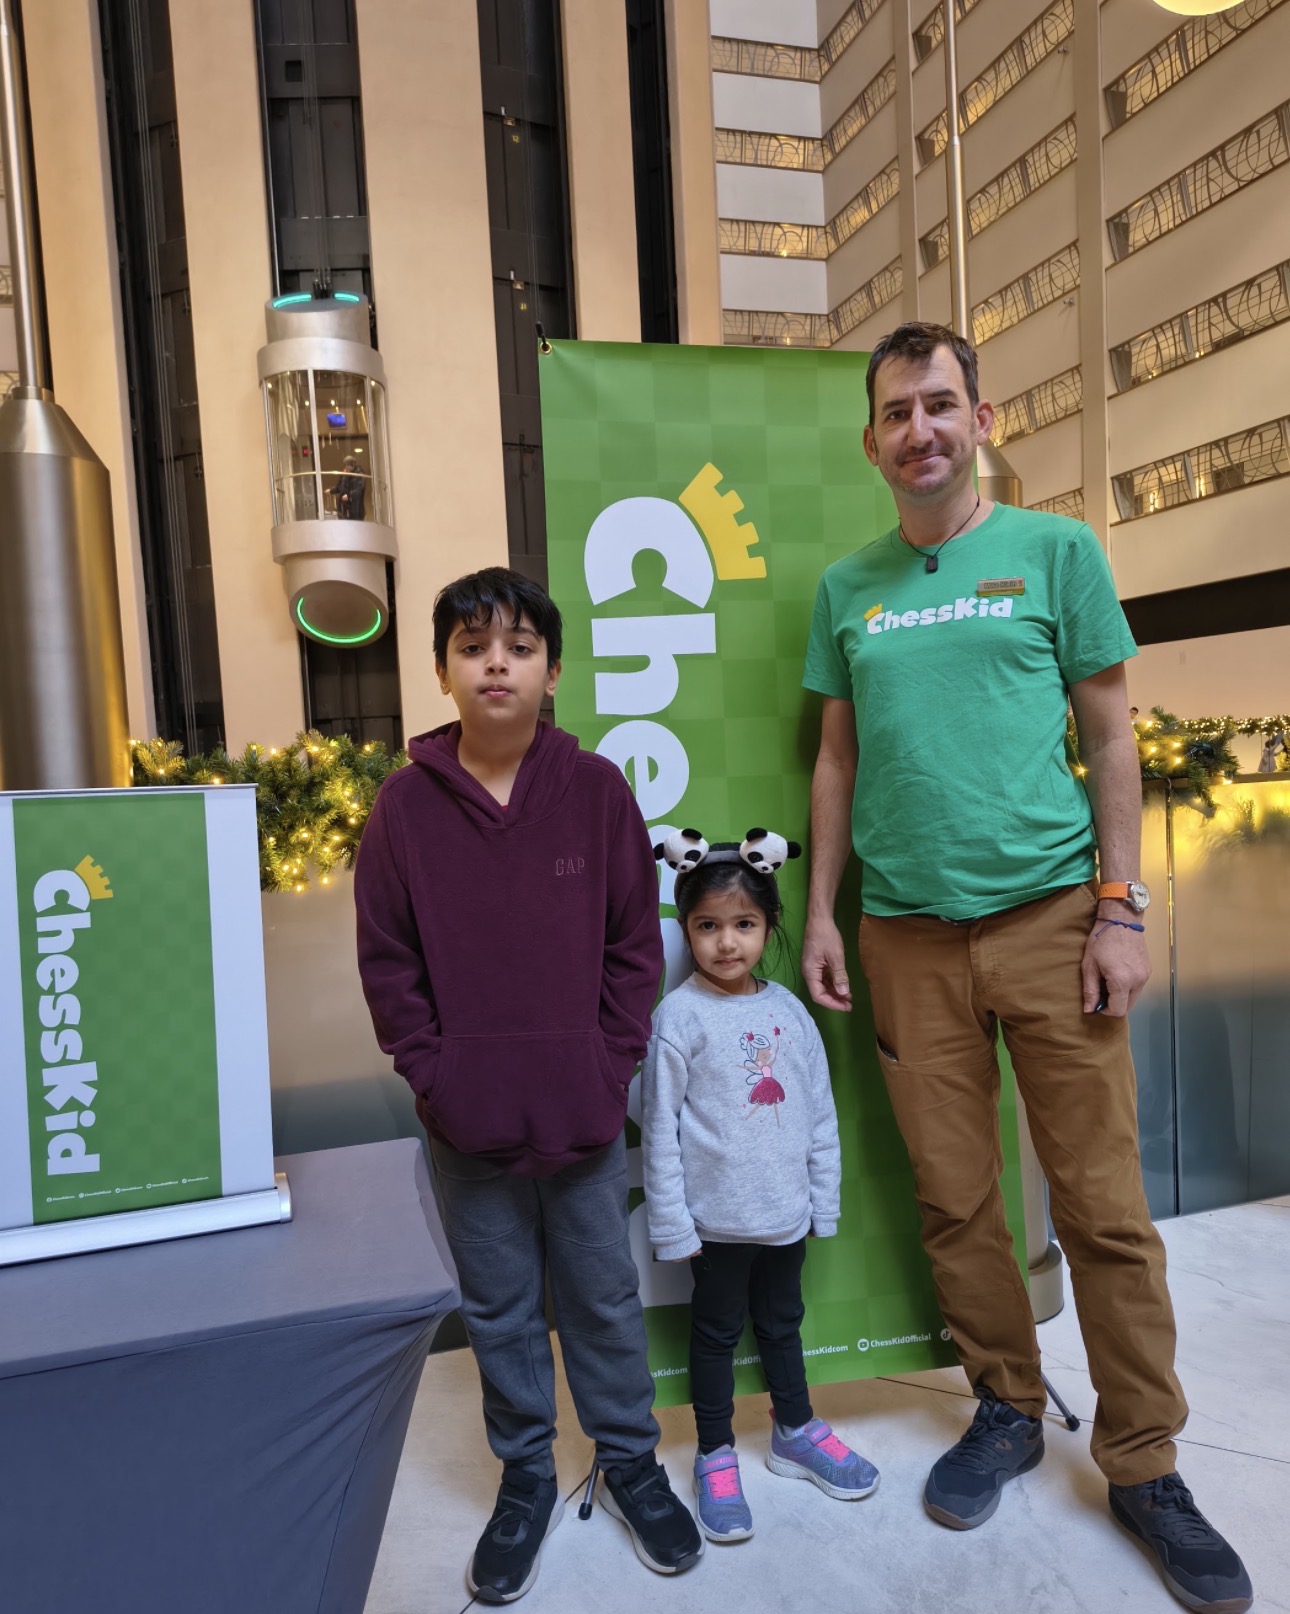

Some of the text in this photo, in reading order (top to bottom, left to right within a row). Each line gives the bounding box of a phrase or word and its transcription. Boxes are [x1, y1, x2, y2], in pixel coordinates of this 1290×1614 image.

[867, 597, 1014, 635] ChessKid
[555, 857, 585, 876] GAP
[33, 869, 101, 1176] ChessKid
[802, 1344, 849, 1357] hessKidcom
[870, 1333, 932, 1348] ChessKidOfficial
